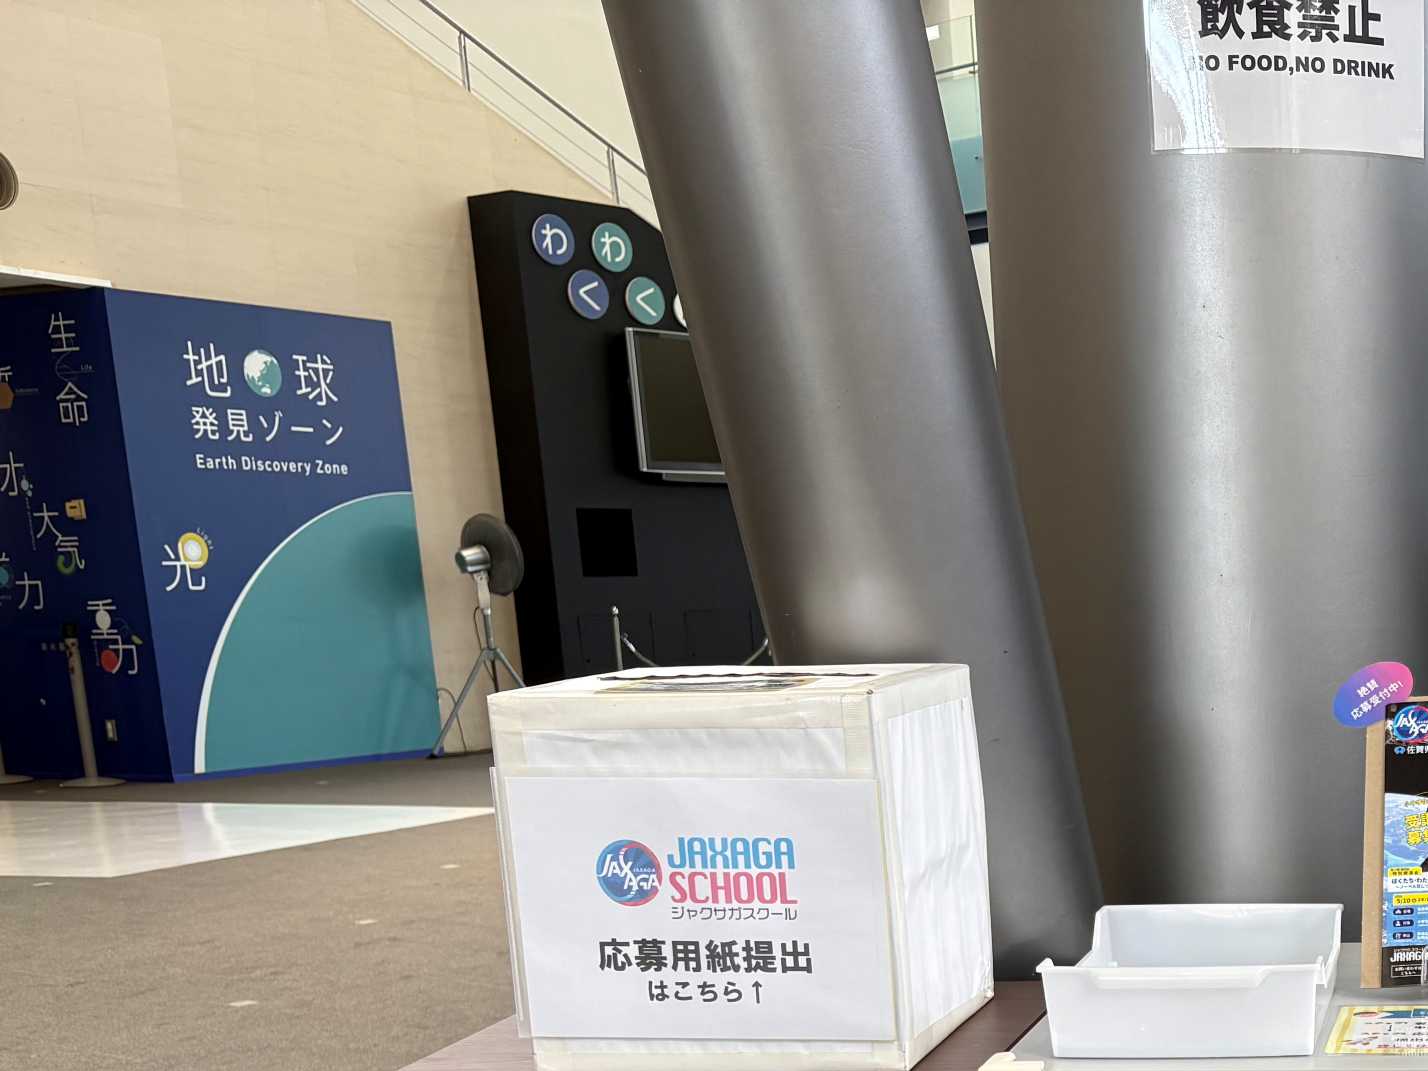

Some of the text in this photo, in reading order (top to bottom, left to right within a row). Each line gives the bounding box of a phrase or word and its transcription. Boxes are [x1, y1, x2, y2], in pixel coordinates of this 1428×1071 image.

[1332, 58, 1394, 80] DRINK
[191, 406, 343, 445] 発見ゾーン
[195, 454, 349, 476] Earth Discovery Zone
[161, 544, 206, 591] 光
[667, 837, 795, 869] JAXAGA
[669, 871, 798, 904] SCHOOL
[599, 938, 812, 974] 応募用紙提出
